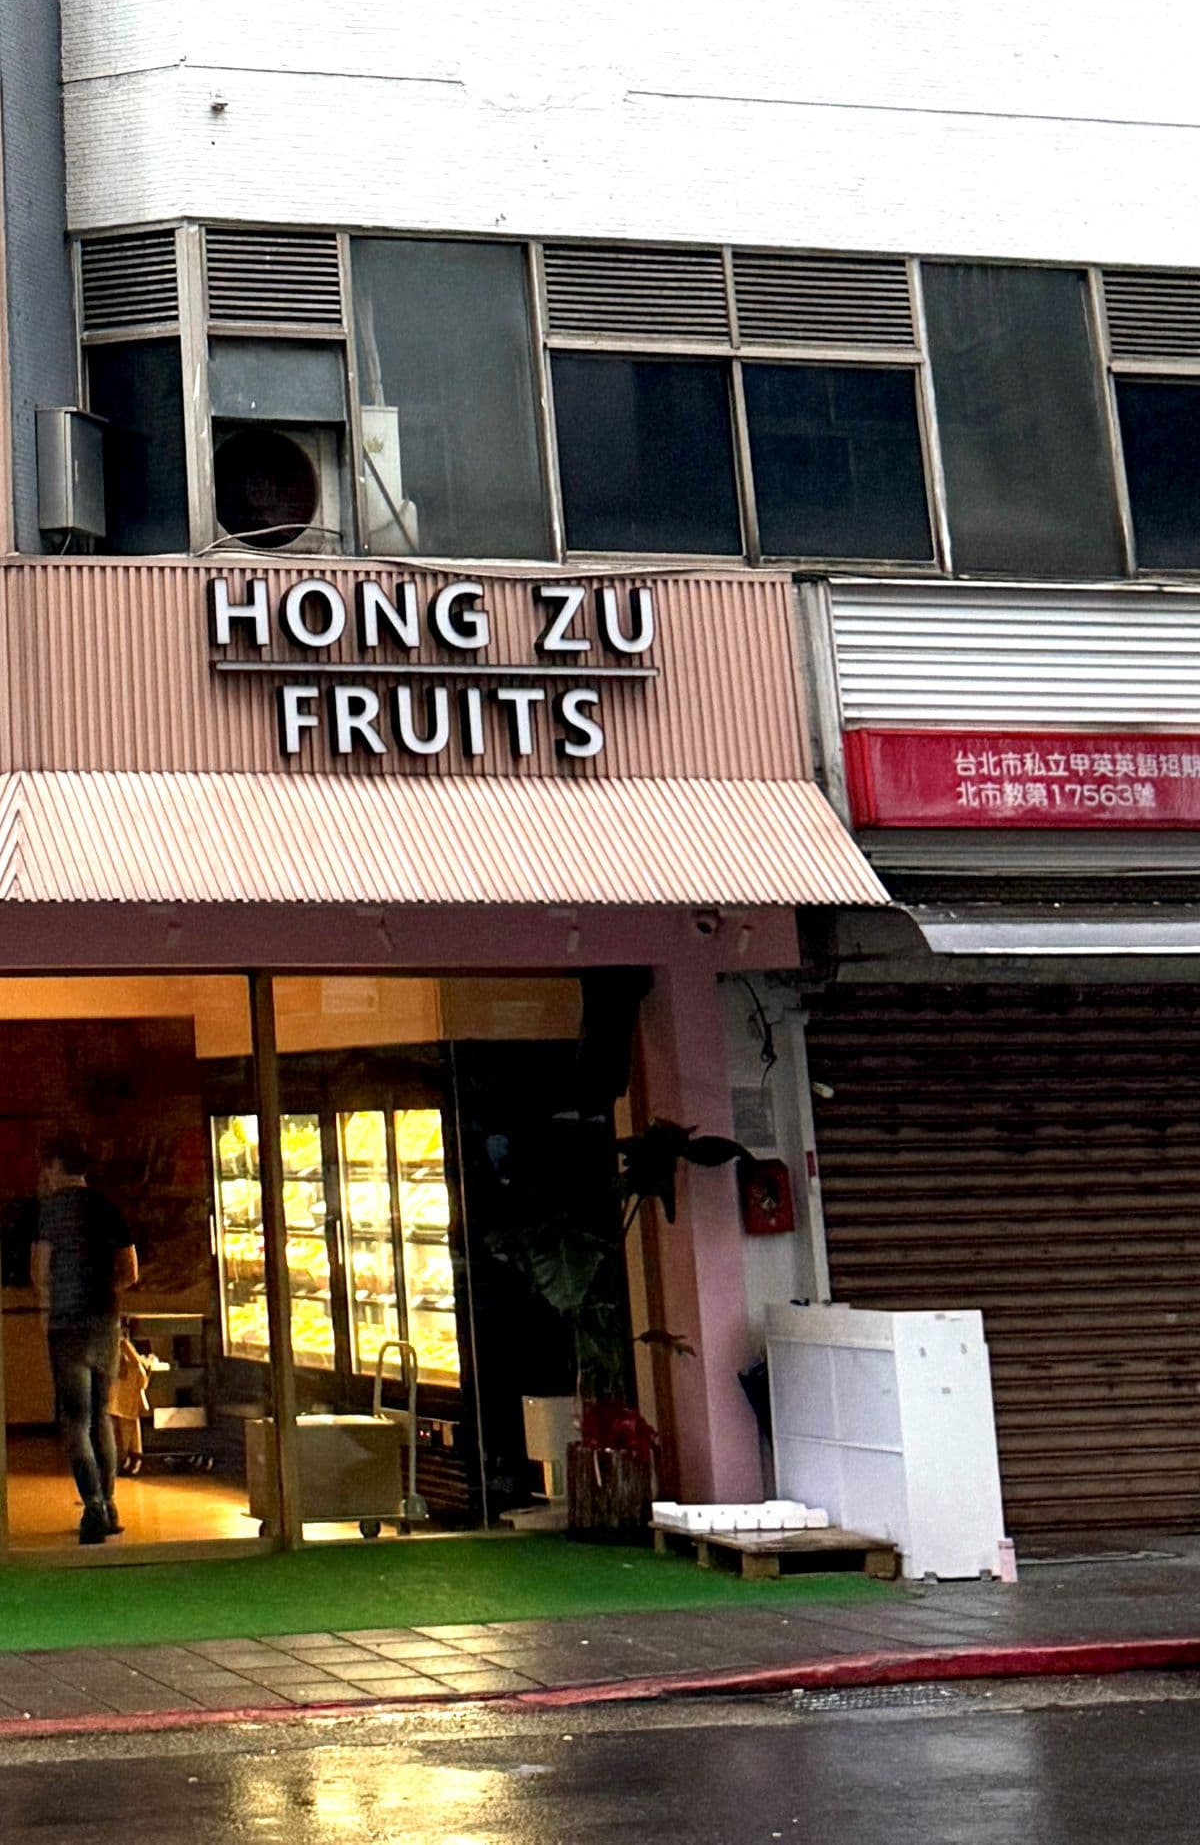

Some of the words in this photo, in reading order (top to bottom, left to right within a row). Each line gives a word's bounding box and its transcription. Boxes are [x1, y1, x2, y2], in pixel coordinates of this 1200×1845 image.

[208, 577, 490, 651] HONG
[534, 583, 656, 655] ZU
[276, 684, 604, 759] FRUITS
